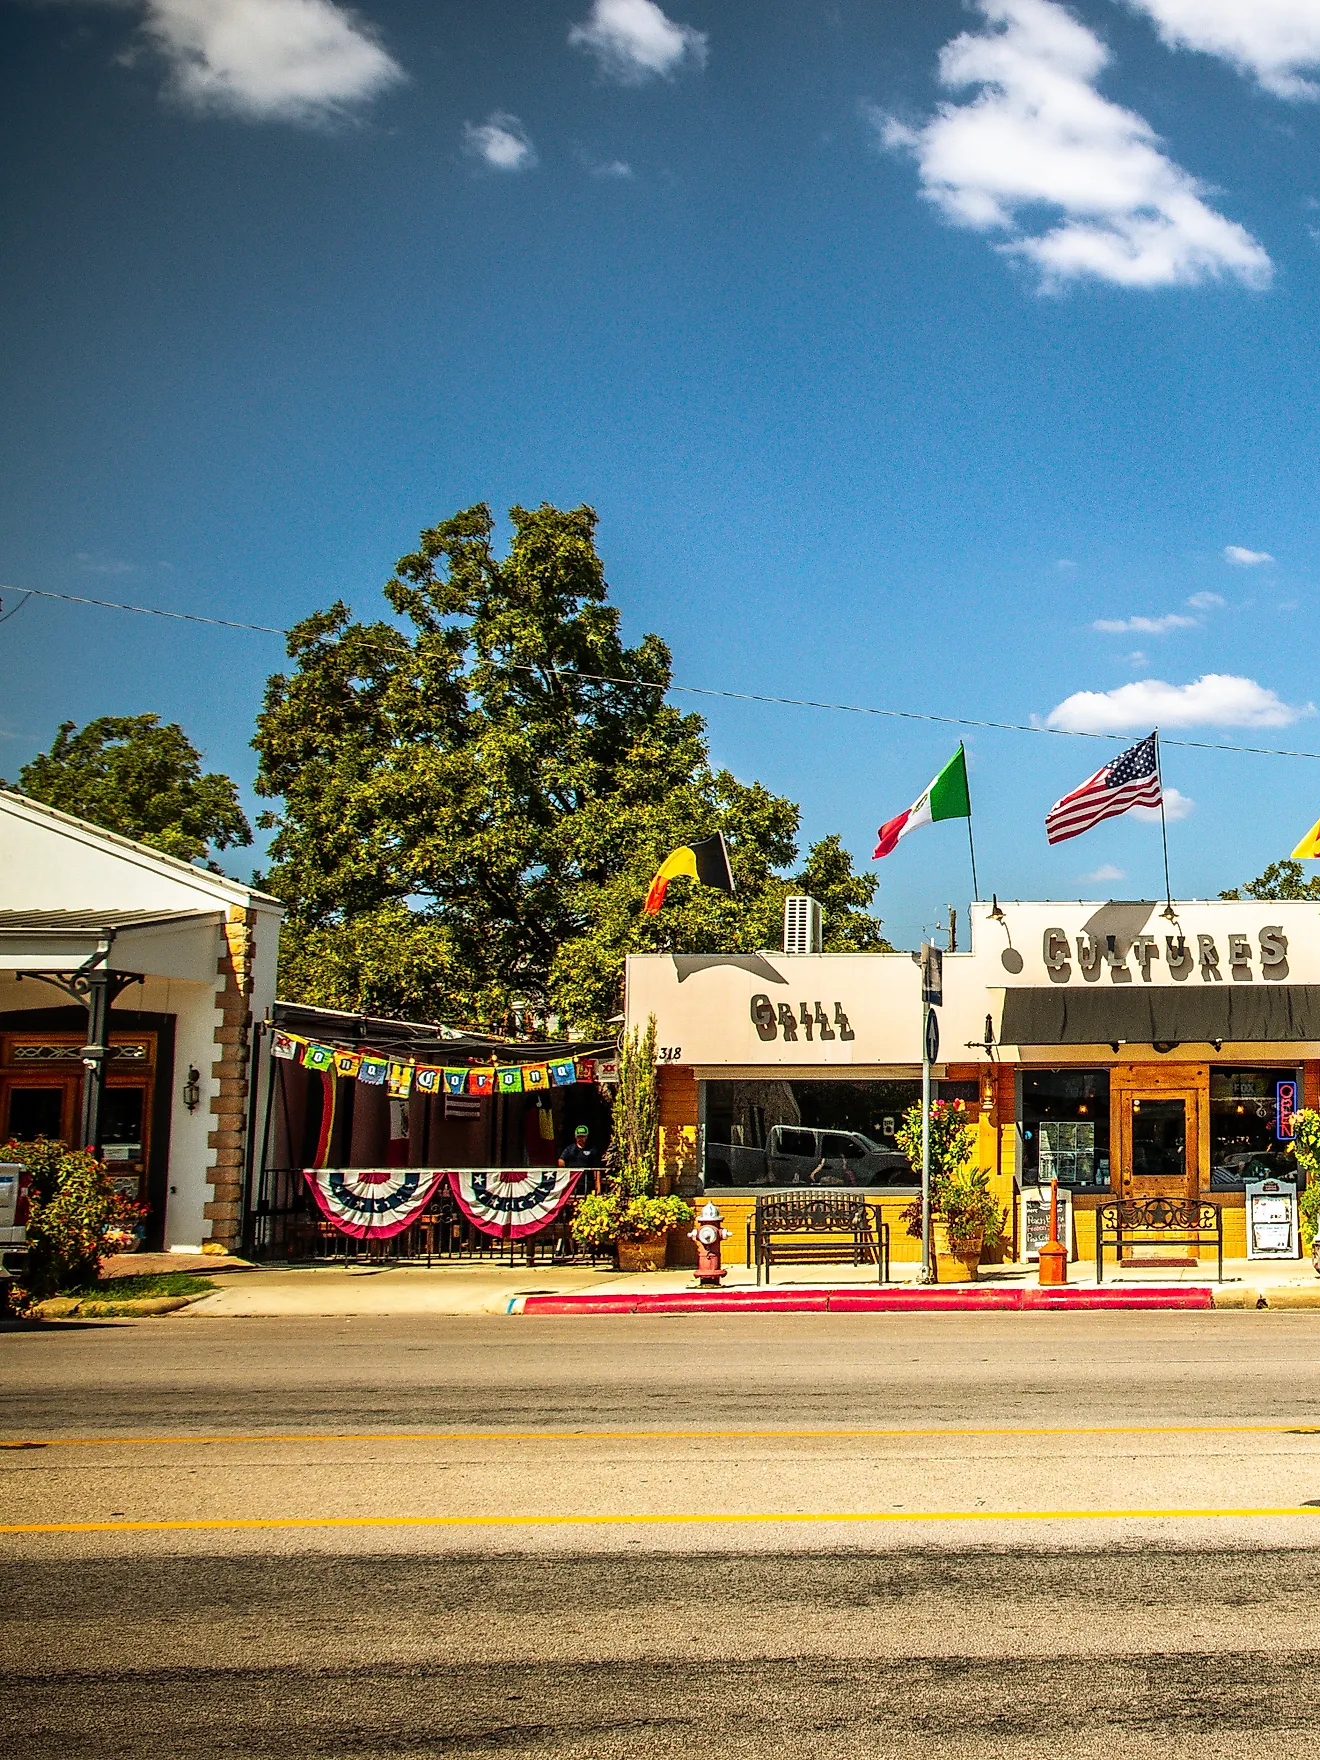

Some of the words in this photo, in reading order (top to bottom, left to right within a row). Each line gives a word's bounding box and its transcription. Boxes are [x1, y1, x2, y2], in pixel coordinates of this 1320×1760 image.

[1042, 926, 1287, 967] CULTURES
[750, 994, 851, 1027] GRILL
[659, 1047, 682, 1060] 318
[1280, 1085, 1294, 1137] OPEN
